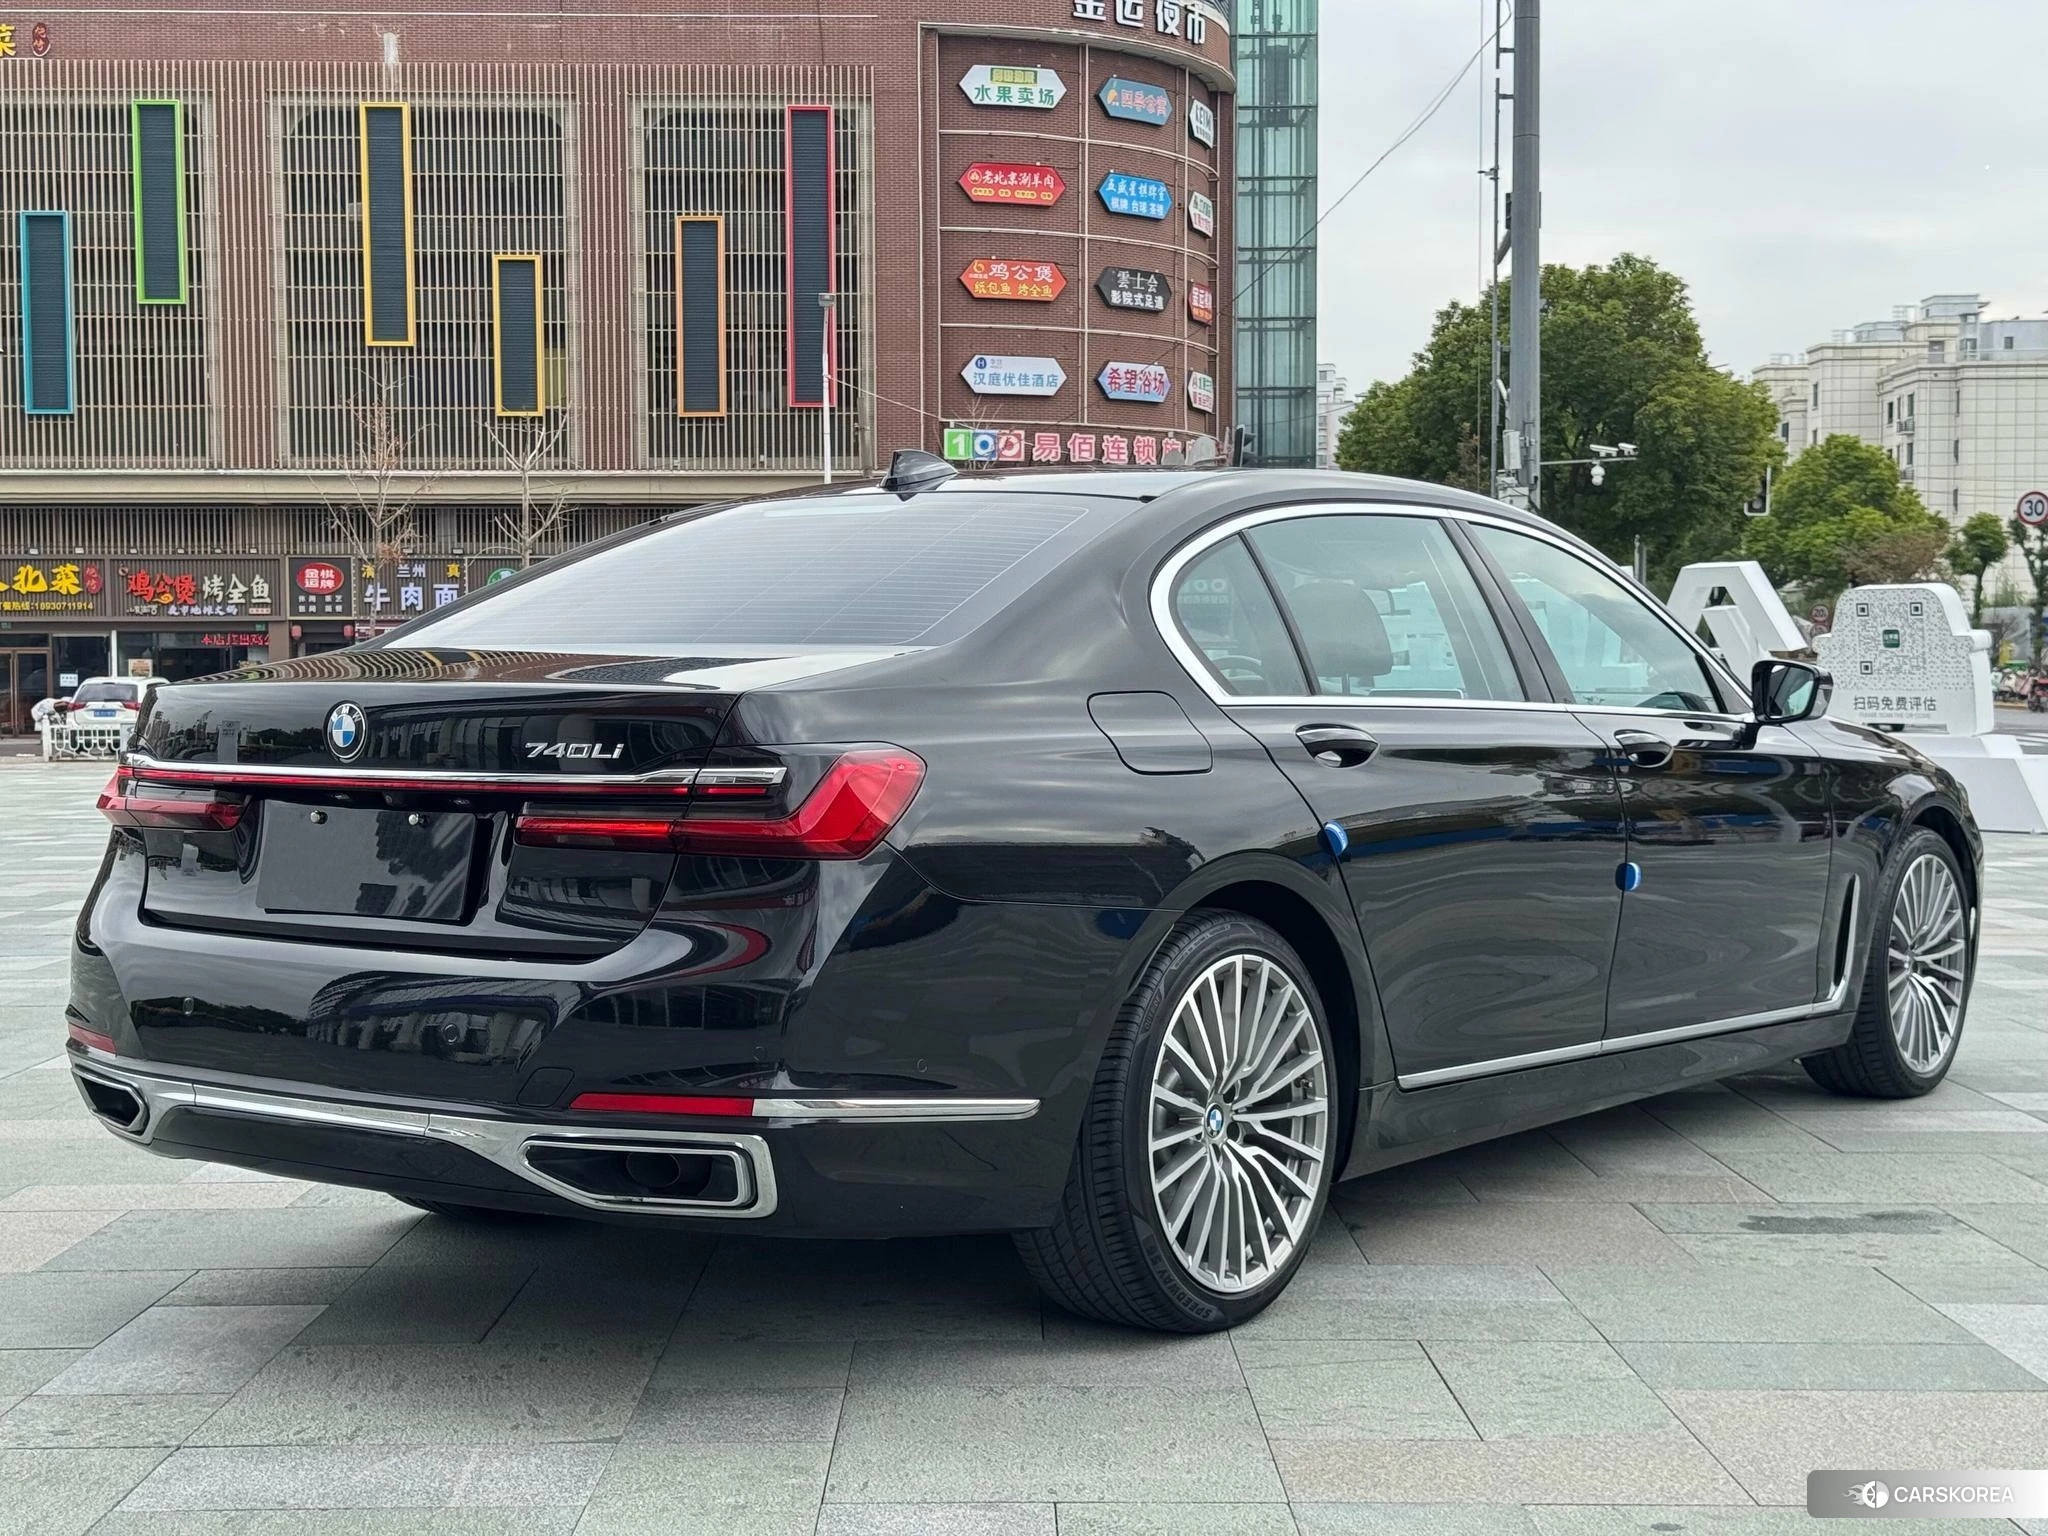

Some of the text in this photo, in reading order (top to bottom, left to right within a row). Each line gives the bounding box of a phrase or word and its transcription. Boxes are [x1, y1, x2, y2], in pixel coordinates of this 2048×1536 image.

[974, 84, 1055, 106] 水果卖场
[982, 170, 1055, 189] 老北京涮羊肉
[988, 263, 1054, 283] 鸡公煲
[974, 281, 1054, 298] 纸包鱼 烤全鱼
[1110, 290, 1165, 311] 影院式足道
[973, 372, 1059, 388] 汉庭优佳酒店
[1107, 367, 1165, 397] 希望浴场
[2024, 500, 2045, 516] 30
[0, 564, 83, 595] 北菜
[397, 564, 426, 578] 兰州
[127, 568, 197, 605] 鸡公煲
[202, 573, 272, 604] 烤全鱼
[363, 582, 460, 612] 牛肉面
[1854, 696, 1936, 711] 扫码免费评估
[525, 742, 624, 759] 740Li
